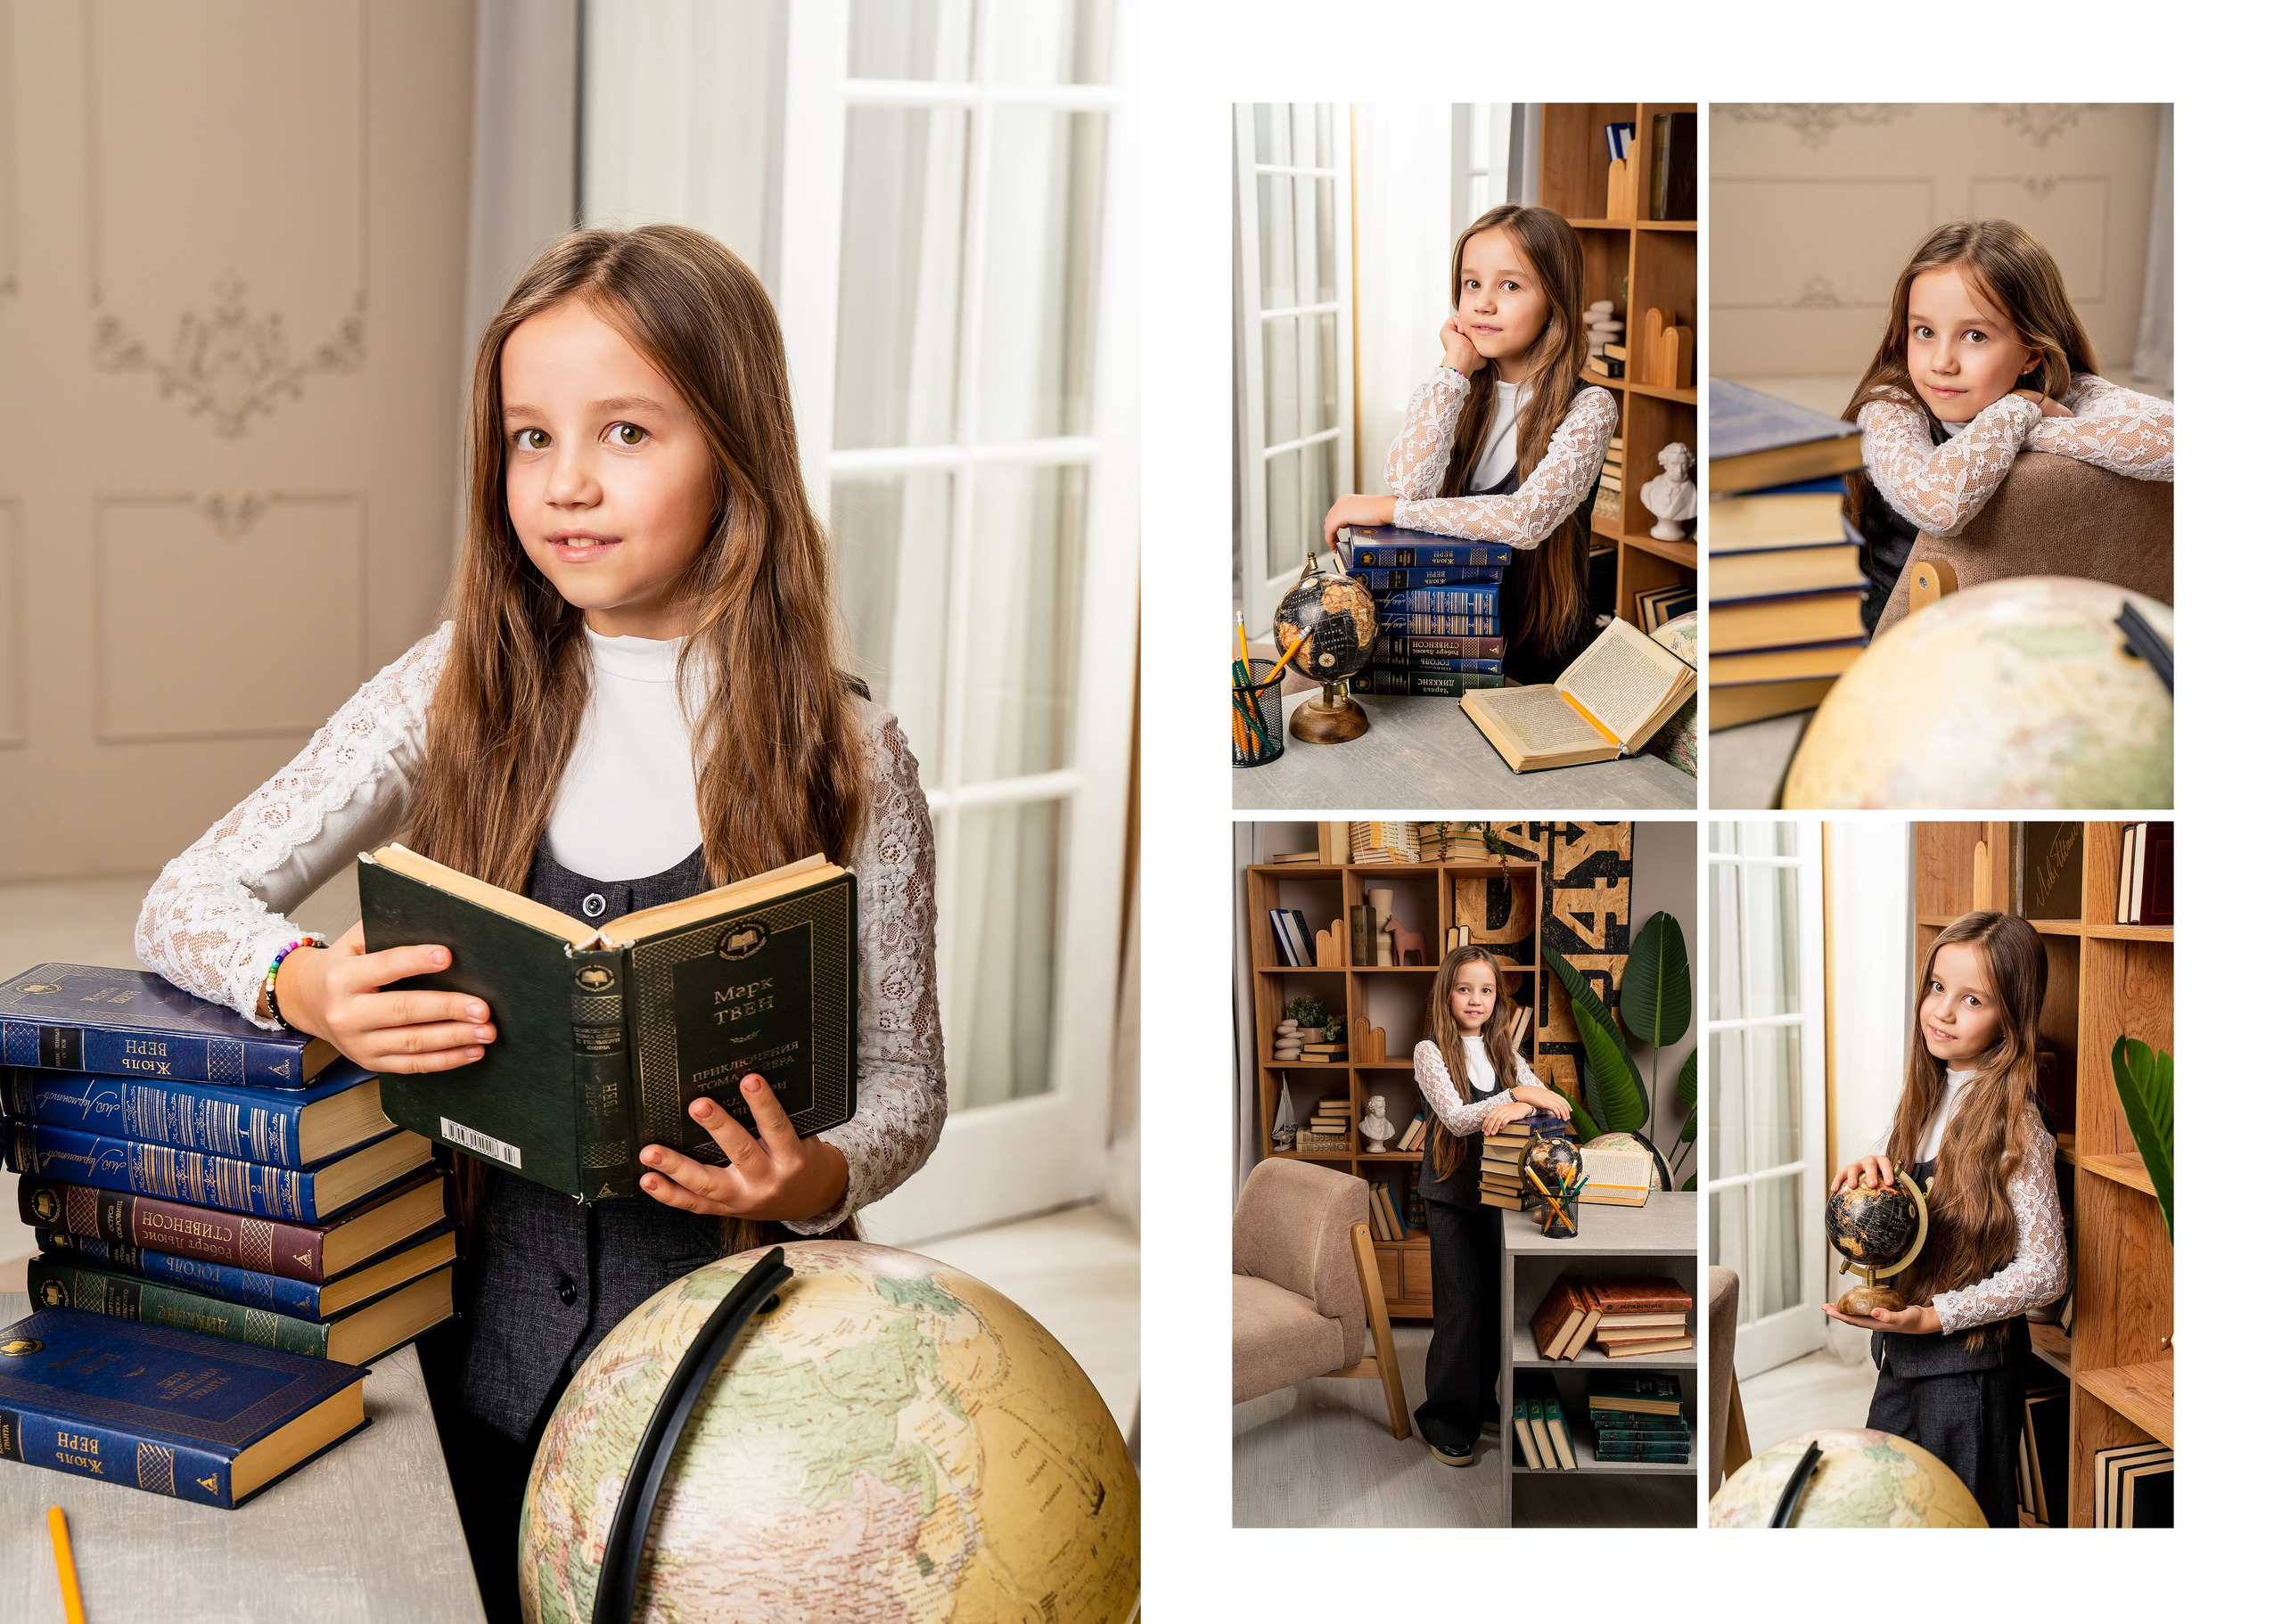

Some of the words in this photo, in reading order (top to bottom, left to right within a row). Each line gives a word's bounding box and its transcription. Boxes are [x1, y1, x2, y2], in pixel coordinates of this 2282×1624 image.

[1412, 641, 1460, 649] СТИВЕНСОН
[1417, 678, 1455, 686] ДИККЕНС
[714, 977, 775, 1005] Марк
[713, 995, 775, 1025] ТВЕН
[126, 1039, 168, 1056] ВЕРН
[122, 1059, 171, 1075] Жюль
[693, 1040, 800, 1083] ПРИКЛЮЧЕНИЯ
[697, 1073, 739, 1093] ТОМА
[240, 1128, 250, 1139] 1
[250, 1185, 263, 1194] 2
[116, 1201, 124, 1238] СОКРОВИЩ
[142, 1210, 233, 1243] СТИВЕНСОН
[142, 1230, 185, 1250] Льюис
[187, 1239, 233, 1259] Роберт
[167, 1257, 220, 1282] ГОГОЛЬ
[157, 1305, 229, 1333] ДИККЕНС
[57, 1431, 99, 1455] ВЕРН
[56, 1452, 104, 1474] Жюль
